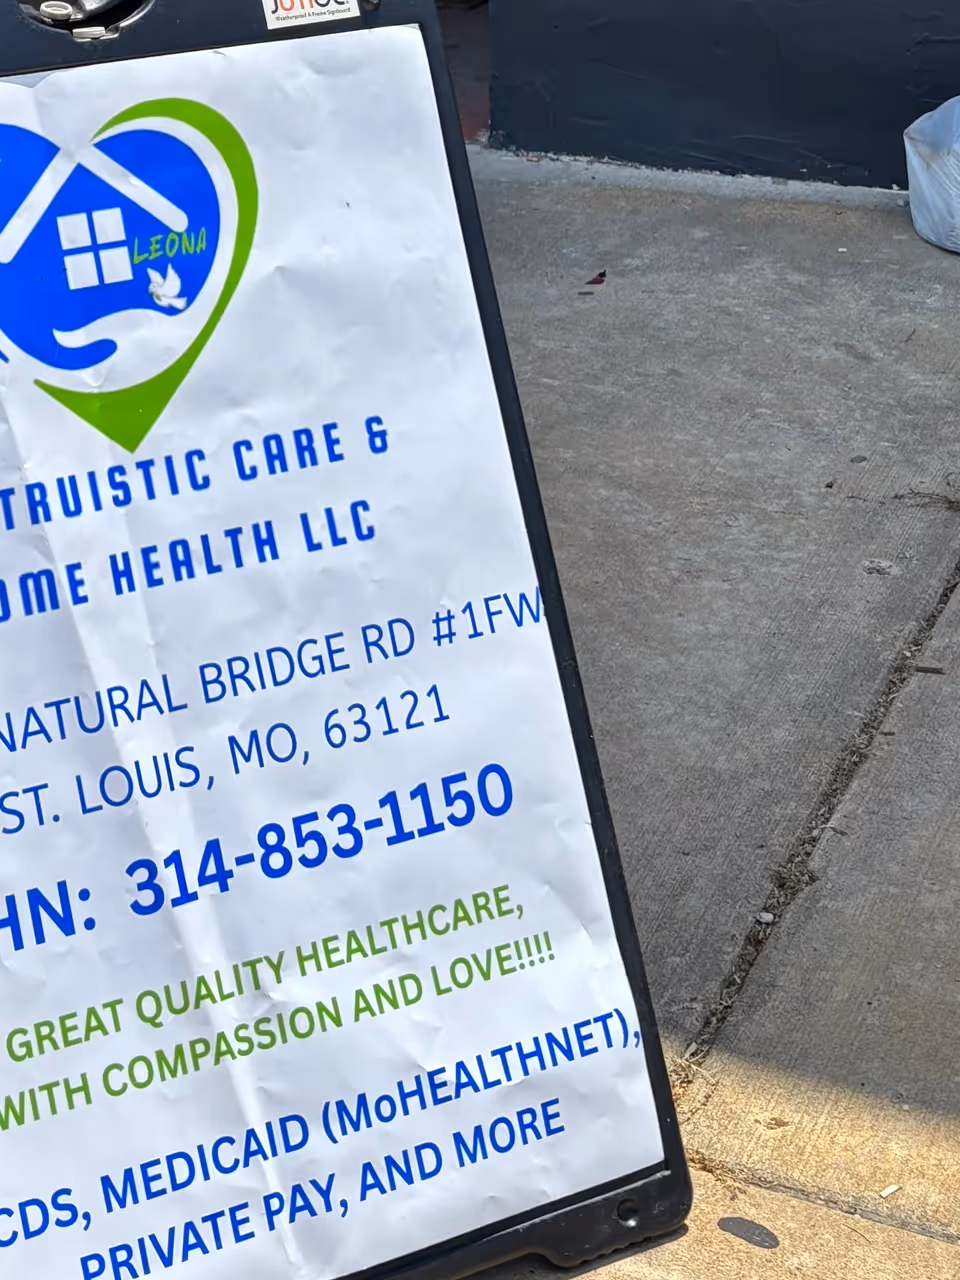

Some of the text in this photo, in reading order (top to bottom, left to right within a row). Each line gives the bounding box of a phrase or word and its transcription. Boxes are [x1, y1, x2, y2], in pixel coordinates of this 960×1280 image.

[132, 226, 207, 265] LEONA
[233, 422, 344, 481] CARE
[365, 416, 388, 454] &
[109, 520, 279, 596] HEALTH
[300, 500, 375, 552] LLC
[199, 633, 350, 703] BRIDGE
[361, 618, 415, 663] RD
[432, 587, 542, 646] #1FW
[0, 685, 449, 834] ST. LOUIS, MO, 63121
[126, 763, 513, 916] 314-853-1150
[5, 886, 524, 1062] GREAT QUALITY HEALTHCARE,
[103, 999, 341, 1096] COMPASSION
[355, 974, 422, 1021] AND
[433, 932, 556, 995] LOVE!!!!
[100, 1114, 309, 1213] MEDICAID
[322, 1009, 640, 1144] (MoHEALTHNET),
[80, 1099, 565, 1280] PRIVATE PAY, AND MORE
